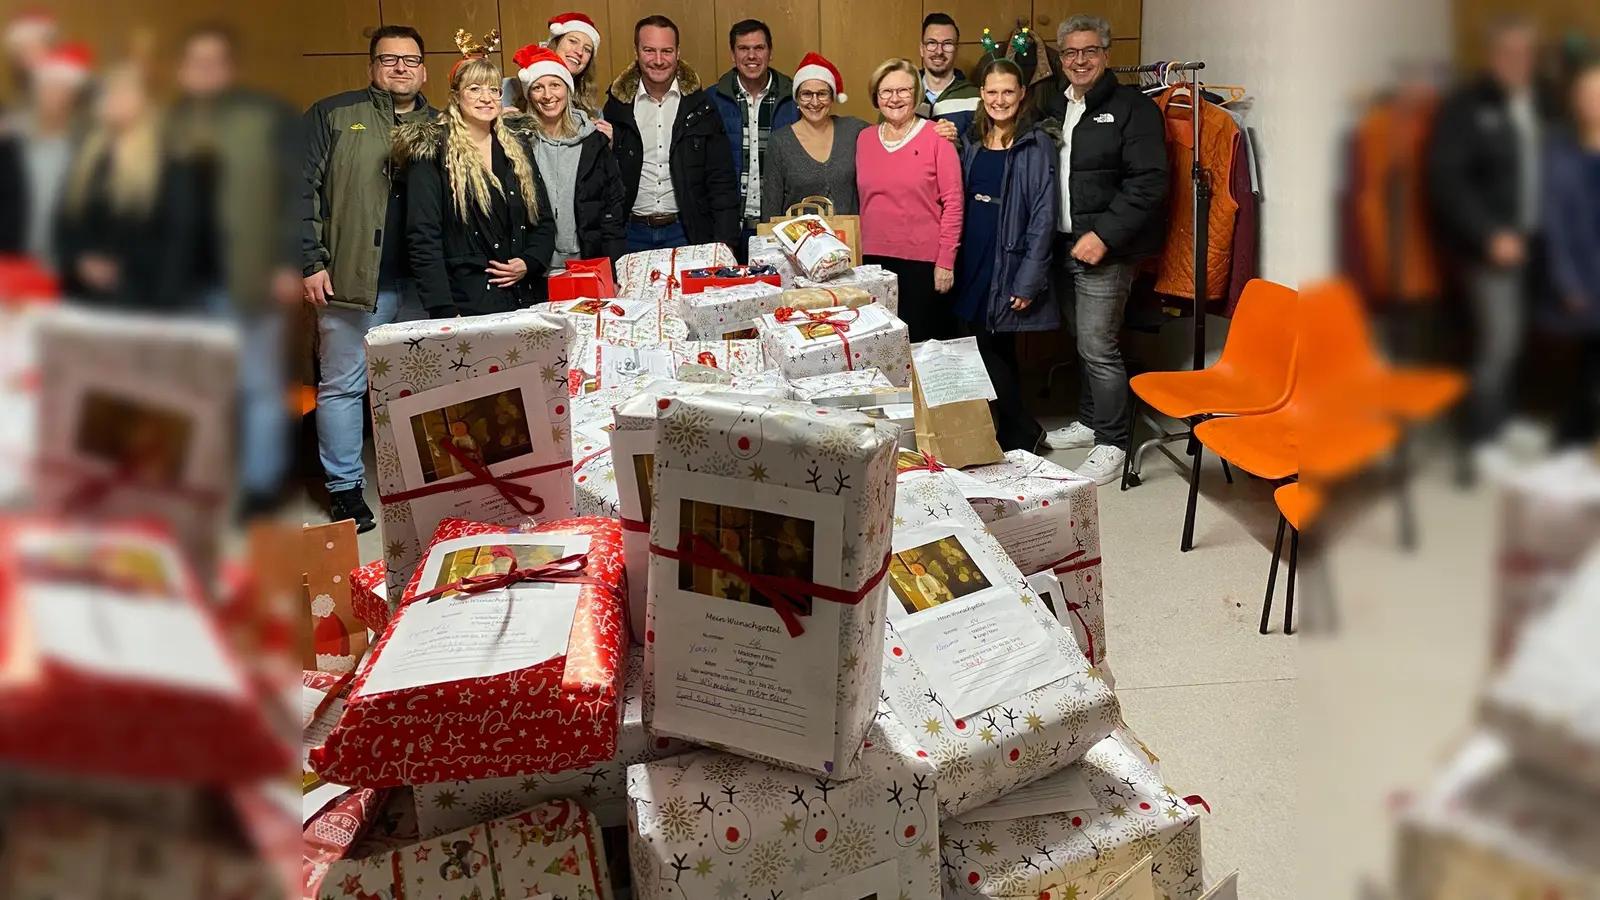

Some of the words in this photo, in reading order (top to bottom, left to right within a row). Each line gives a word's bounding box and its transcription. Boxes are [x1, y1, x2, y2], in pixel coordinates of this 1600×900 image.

[705, 612, 726, 623] Mein
[361, 708, 510, 734] Christmas
[507, 701, 582, 725] Merry
[428, 751, 579, 772] Christmas
